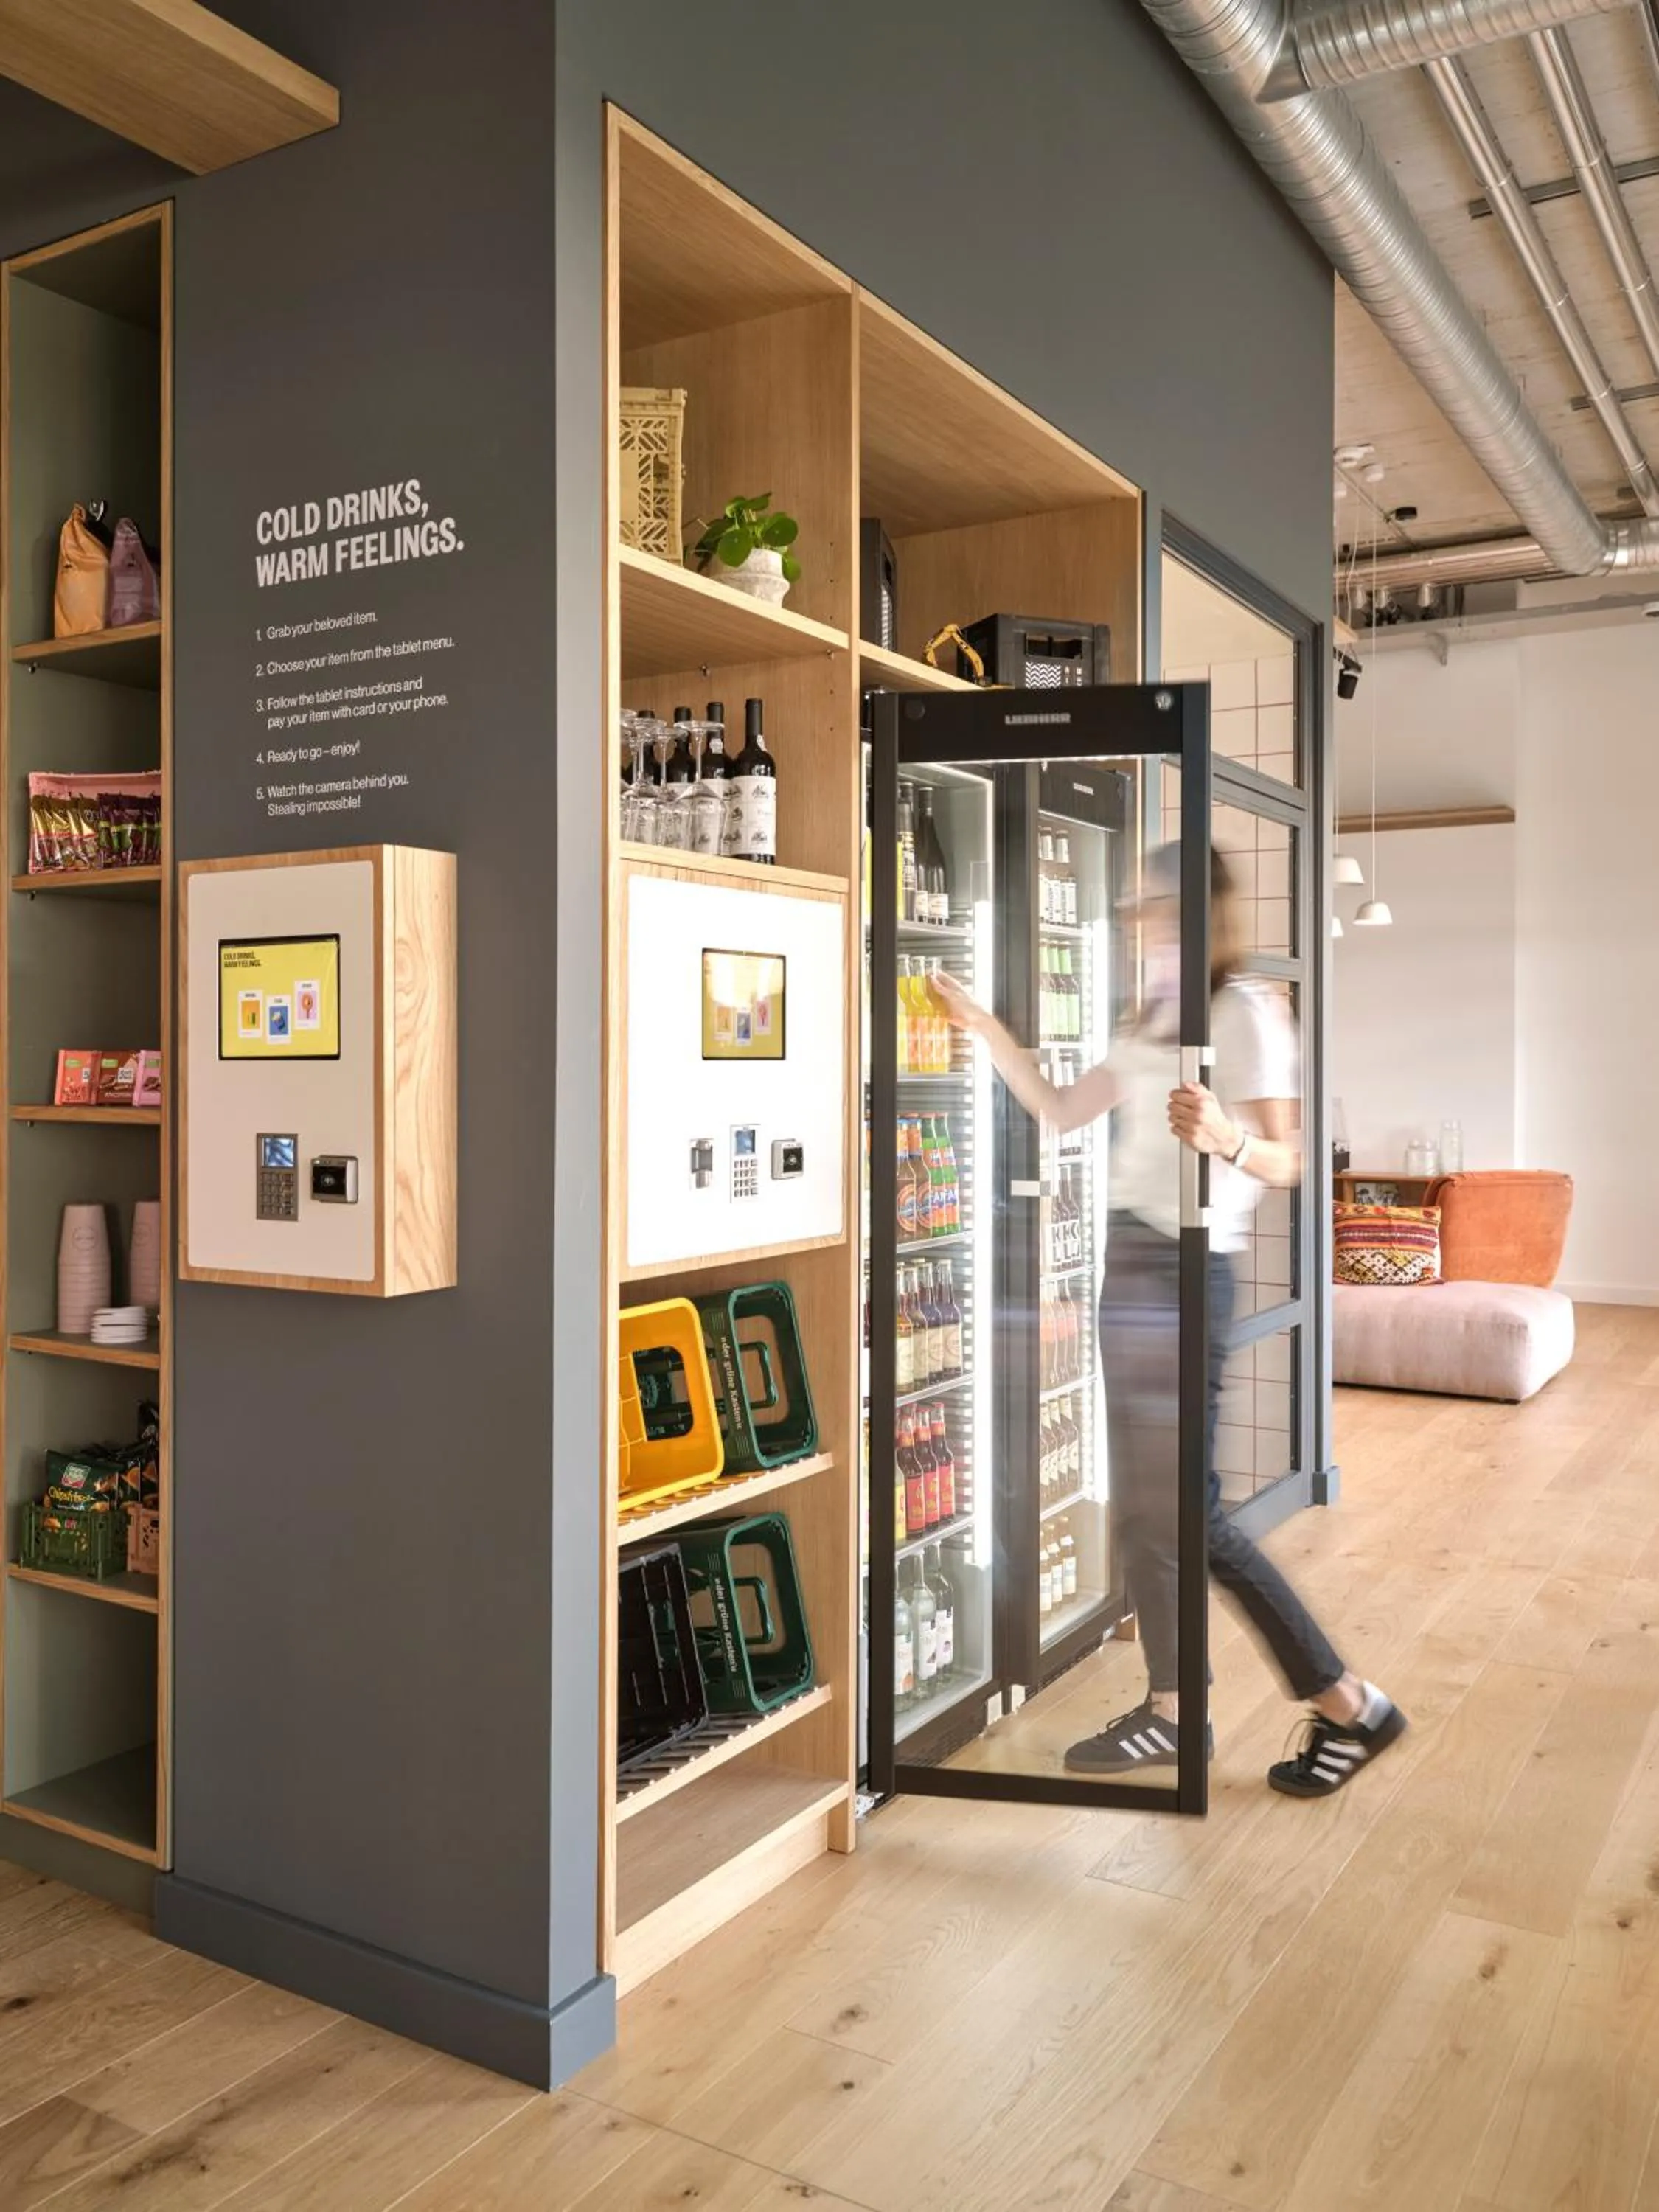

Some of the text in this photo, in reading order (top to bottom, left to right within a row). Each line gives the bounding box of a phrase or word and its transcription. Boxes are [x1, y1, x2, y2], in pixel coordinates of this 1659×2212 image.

[257, 479, 428, 545] COLD DRINKS,
[256, 517, 465, 588] WARM FEELINGS.
[266, 625, 291, 639] Grab
[291, 623, 313, 638] your
[314, 613, 353, 631] beloved
[354, 612, 378, 625] item.
[256, 637, 455, 677] 2. Choose your item from the tablet menu.
[256, 676, 422, 712] 3. Follow the tablet instructions and
[268, 694, 449, 730] pay your item with card or your phone.
[256, 752, 265, 765] 4.
[268, 748, 296, 763] Ready
[299, 747, 309, 759] to
[310, 747, 322, 761] go
[330, 739, 360, 758] enjoy!
[256, 773, 409, 800] 5. Watch the camera behind you.
[268, 795, 361, 816] Stealing impossible!
